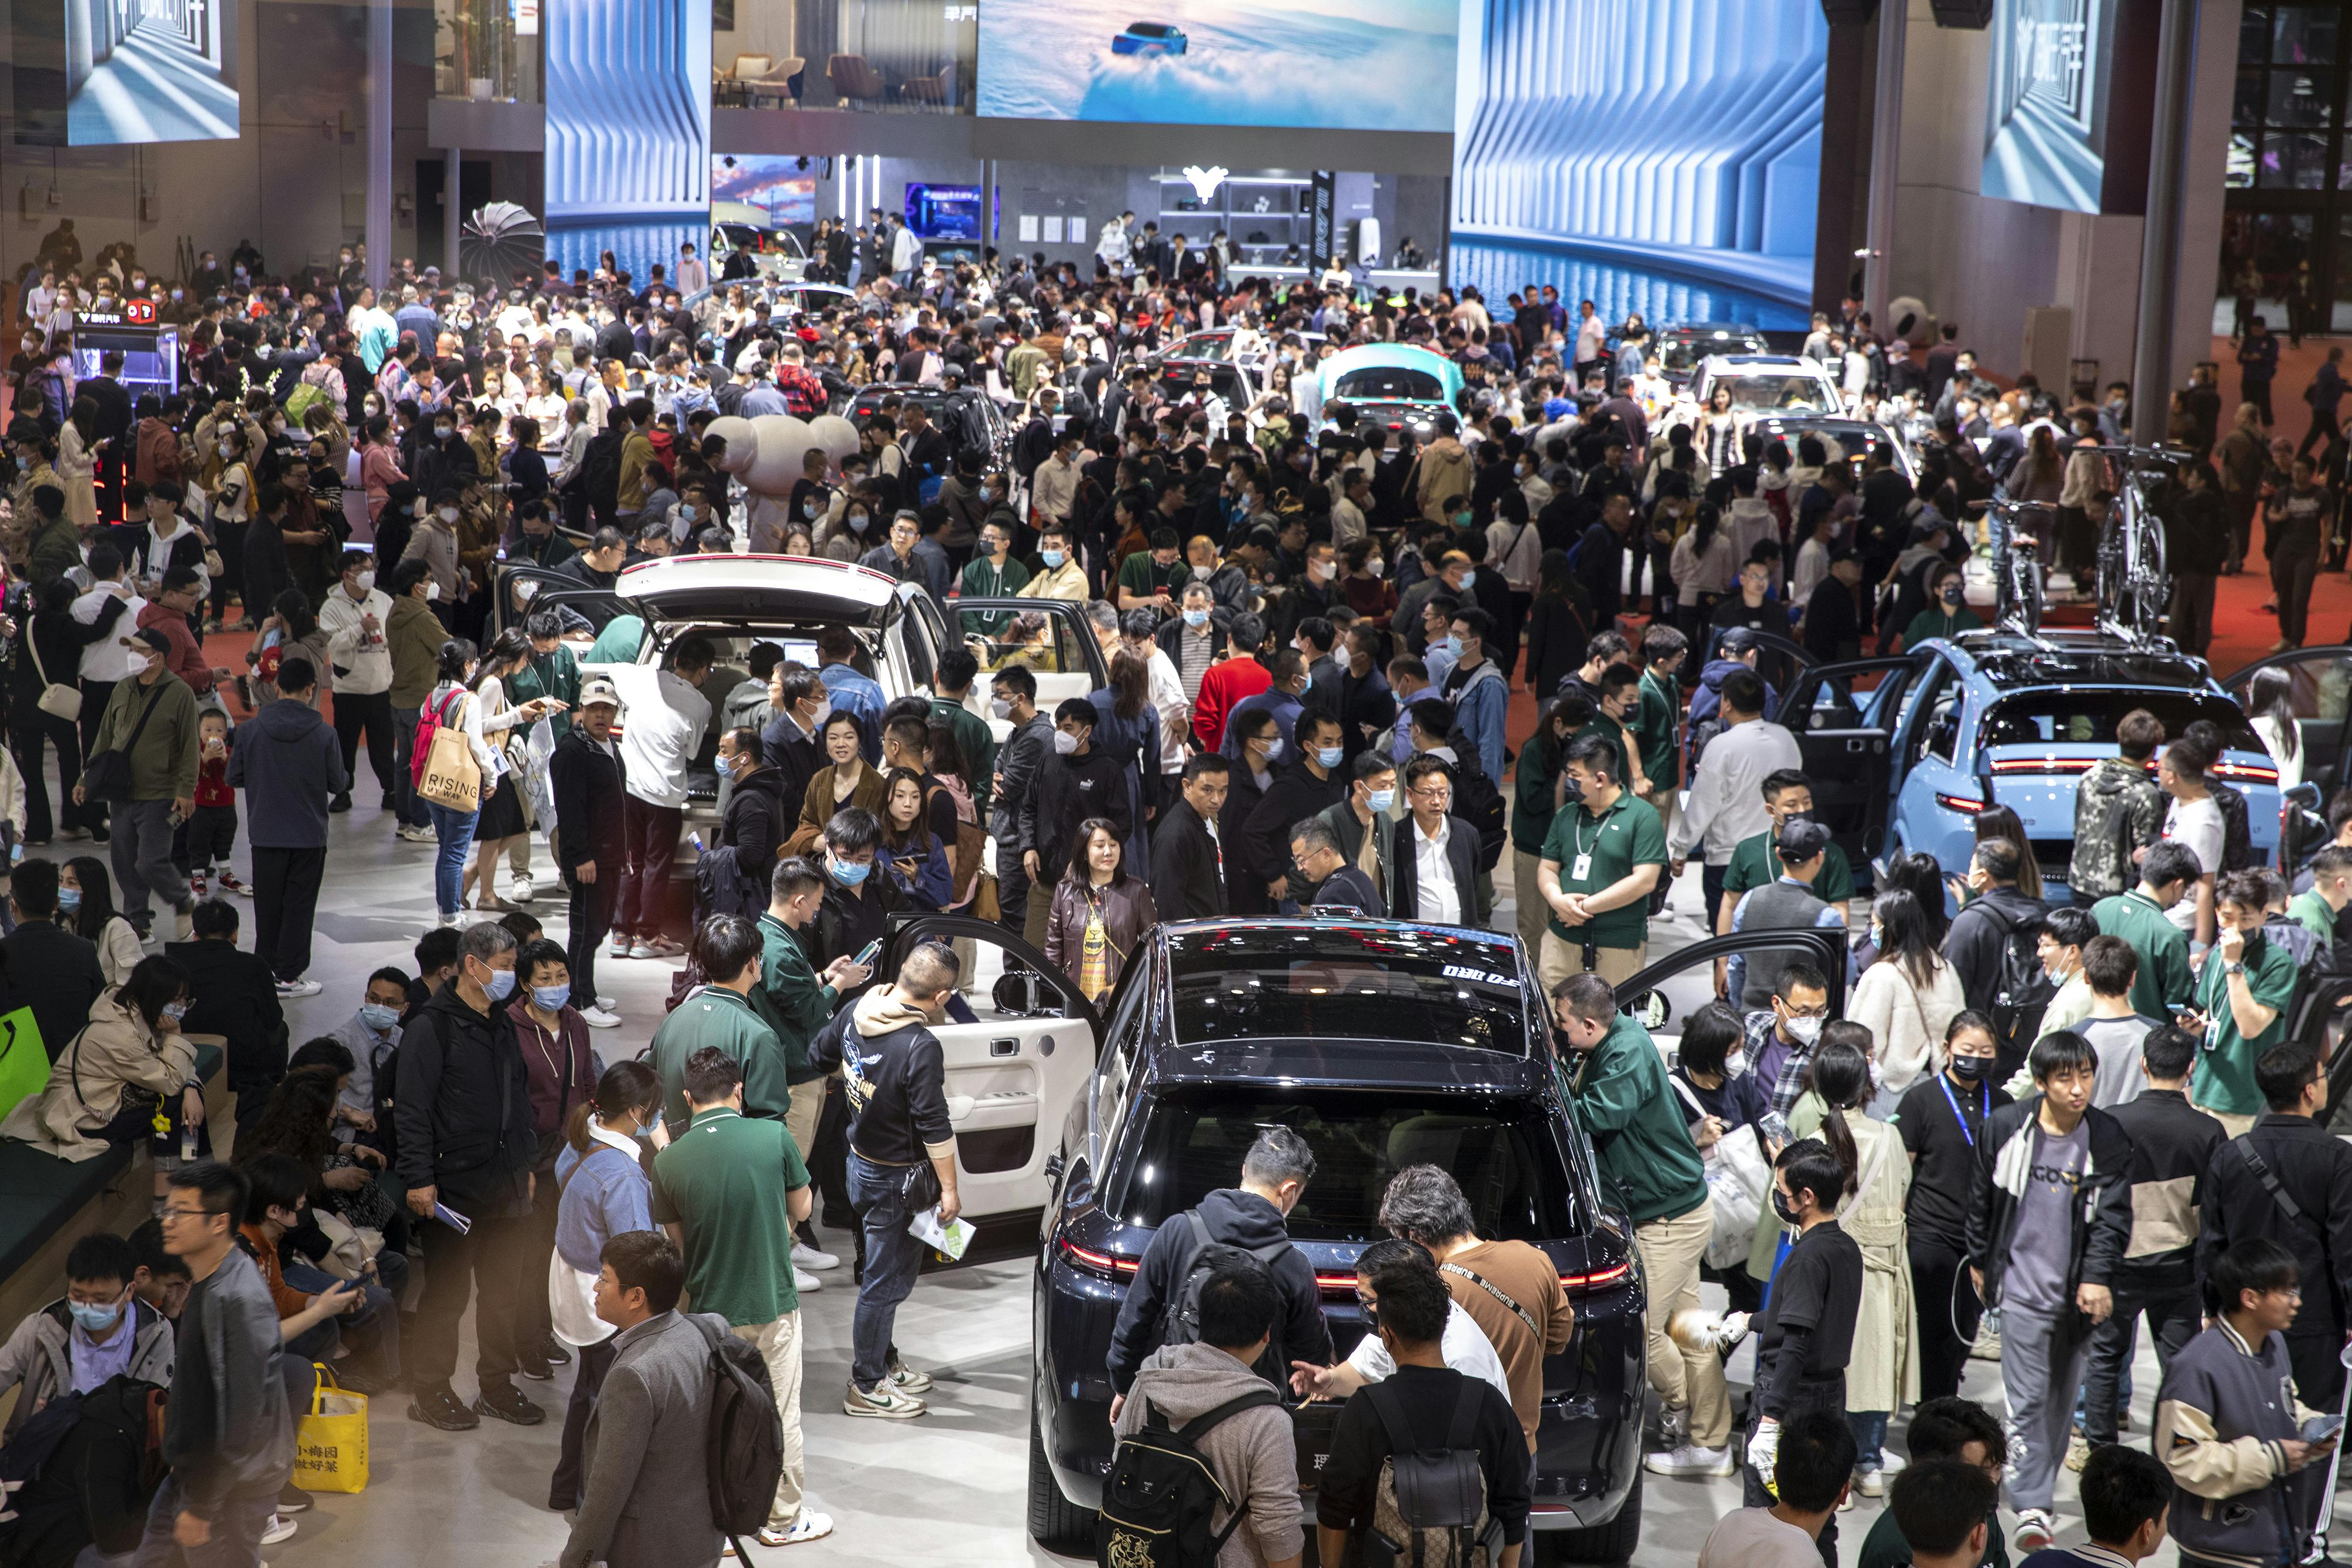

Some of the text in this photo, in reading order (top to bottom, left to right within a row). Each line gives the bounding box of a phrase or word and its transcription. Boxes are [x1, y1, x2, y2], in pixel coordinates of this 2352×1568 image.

[427, 785, 461, 800] MY WAY
[429, 774, 477, 799] RISING
[1479, 1278, 1515, 1309] SUPREME
